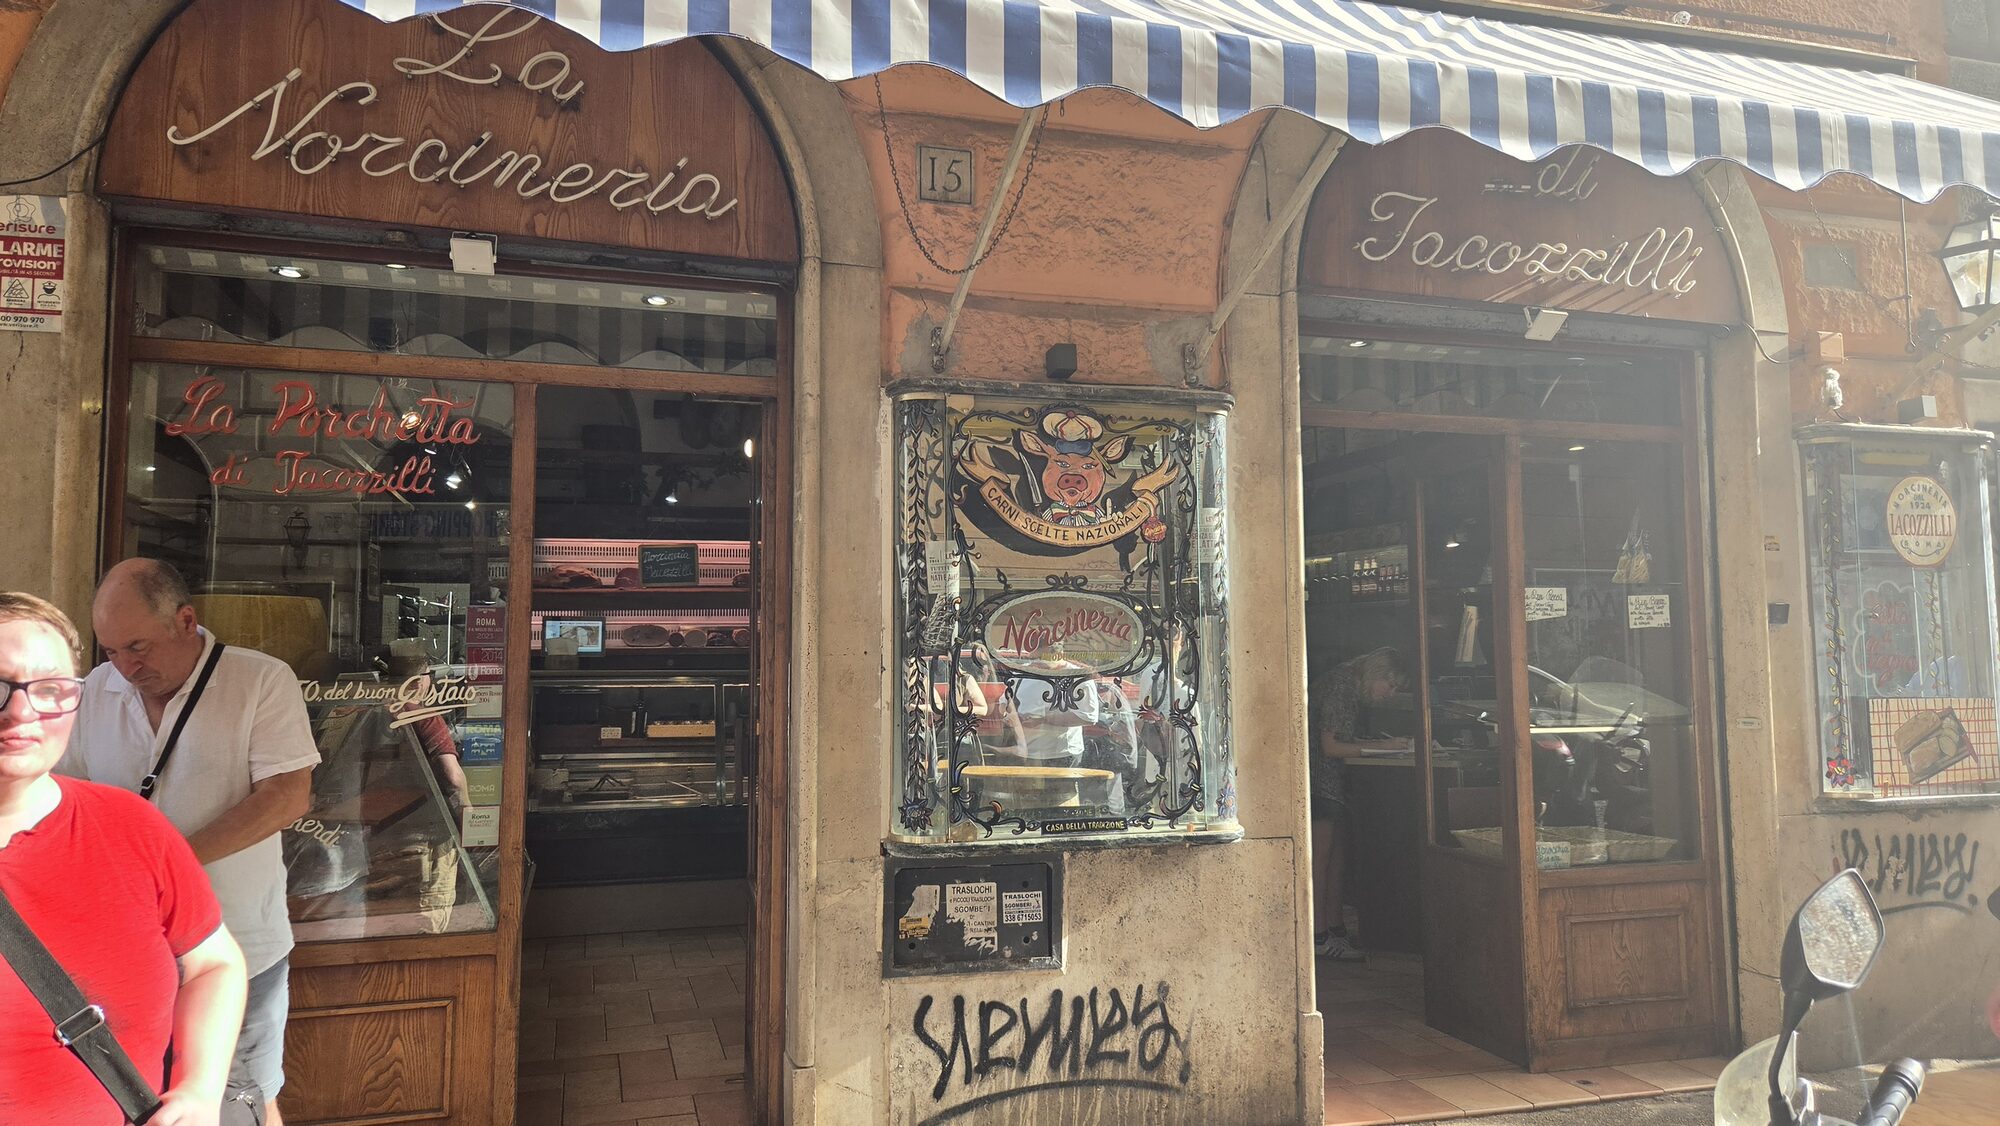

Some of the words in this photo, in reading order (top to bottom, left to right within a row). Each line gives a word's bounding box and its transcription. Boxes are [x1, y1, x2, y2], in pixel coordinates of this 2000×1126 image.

[392, 6, 586, 104] La
[166, 66, 740, 220] Norcineria
[928, 156, 963, 193] 15
[1536, 144, 1601, 201] di
[0, 222, 56, 235] erisure
[0, 240, 64, 258] LARME
[13, 315, 29, 323] 970
[29, 316, 45, 324] 970
[165, 376, 240, 437] La
[268, 378, 483, 445] Porchetta
[209, 453, 250, 486] di
[1893, 483, 1948, 509] NORCINERIA
[987, 486, 1021, 522] CARNI
[1021, 517, 1070, 542] SCELTE
[1076, 506, 1144, 542] NAZIONALI
[1889, 513, 1953, 537] IACOZZILLI
[1904, 540, 1942, 548] ROMA
[475, 618, 496, 627] ROMA
[998, 607, 1132, 658] Norcineria
[481, 650, 503, 662] 2014
[480, 667, 503, 675] Roma
[323, 680, 352, 700] del
[355, 681, 396, 700] buon
[389, 674, 479, 714] Gustaio
[465, 724, 502, 735] ROMA
[469, 784, 495, 793] ROMA
[1045, 823, 1064, 832] CASA
[1065, 822, 1086, 831] DELLA
[1087, 820, 1125, 830] TRADIZIONE
[952, 885, 992, 895] TRASLOCHI
[1004, 892, 1041, 900] TRASLOCHI
[1005, 914, 1016, 923] 338
[1017, 912, 1042, 922] 6715053
